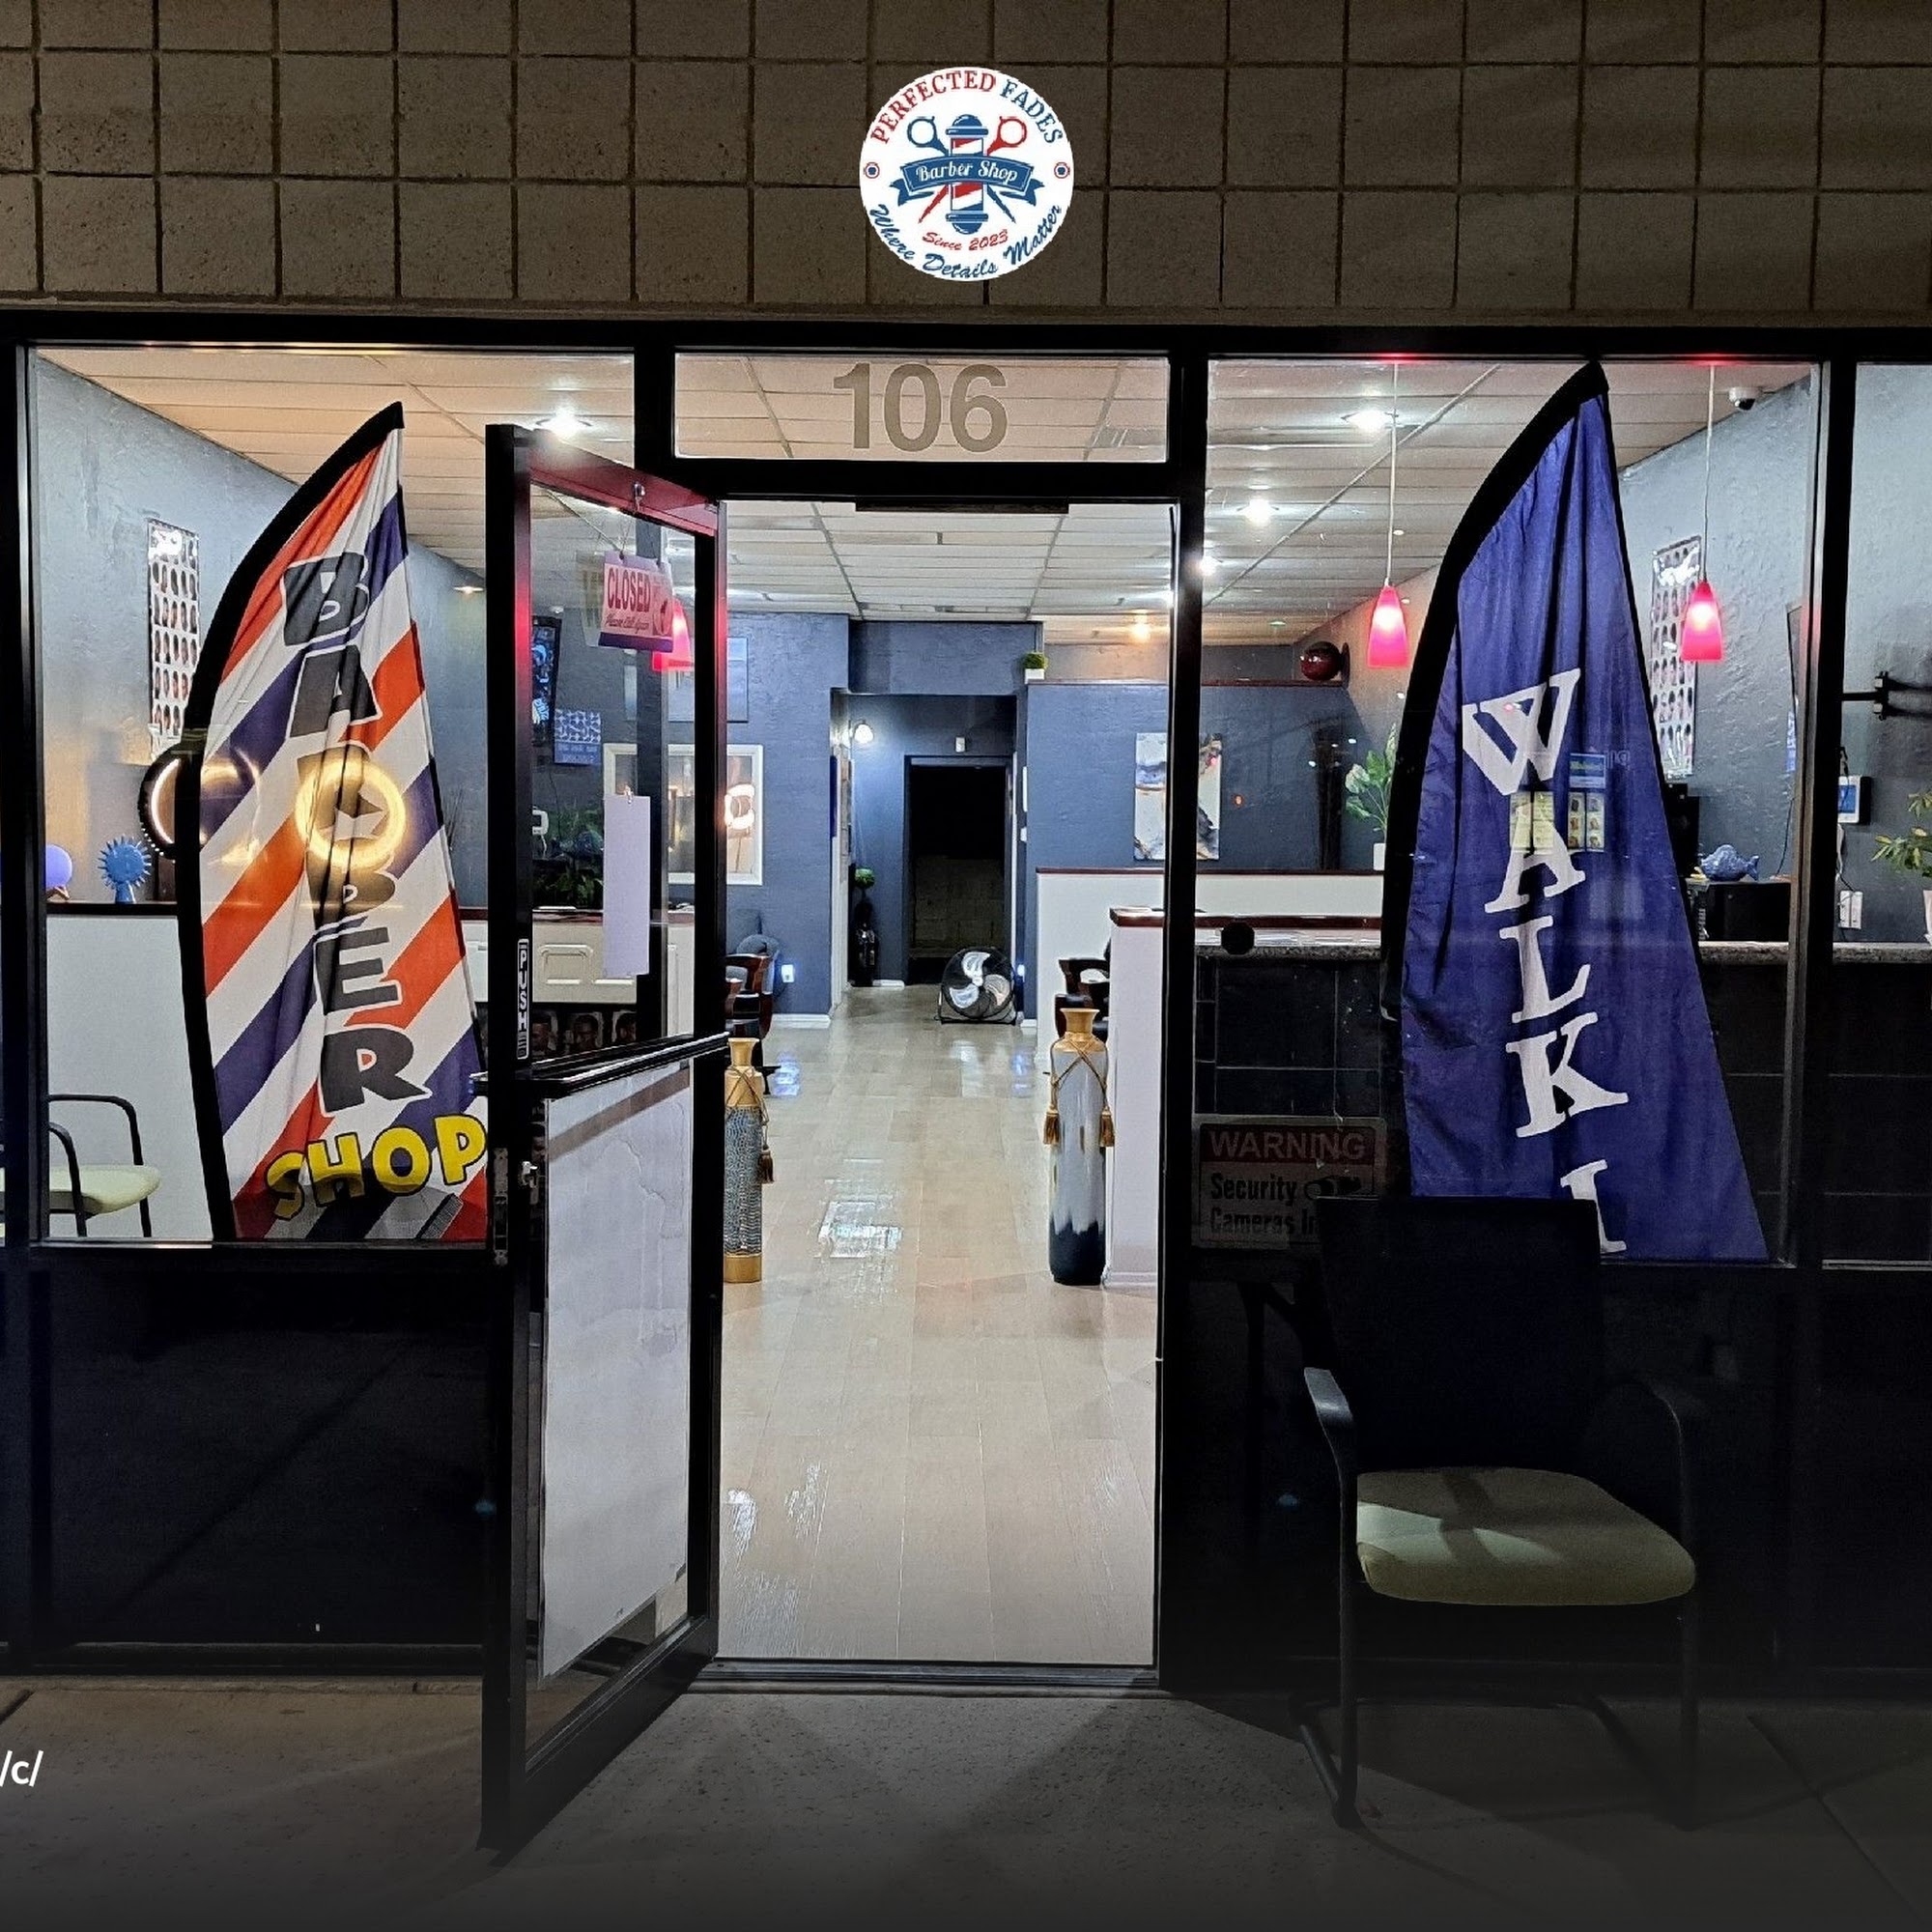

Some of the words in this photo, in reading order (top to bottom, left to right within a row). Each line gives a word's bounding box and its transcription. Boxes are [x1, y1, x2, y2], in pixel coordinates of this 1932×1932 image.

[834, 362, 1009, 452] 106
[607, 567, 651, 612] CLOSED
[280, 553, 431, 1115] BARBER
[1462, 668, 1629, 1138] WALK
[518, 948, 528, 1031] PUSH
[266, 1114, 486, 1220] SHOP
[1209, 1129, 1366, 1160] WARNING
[1210, 1172, 1297, 1206] Security
[1210, 1207, 1295, 1235] Cameras
